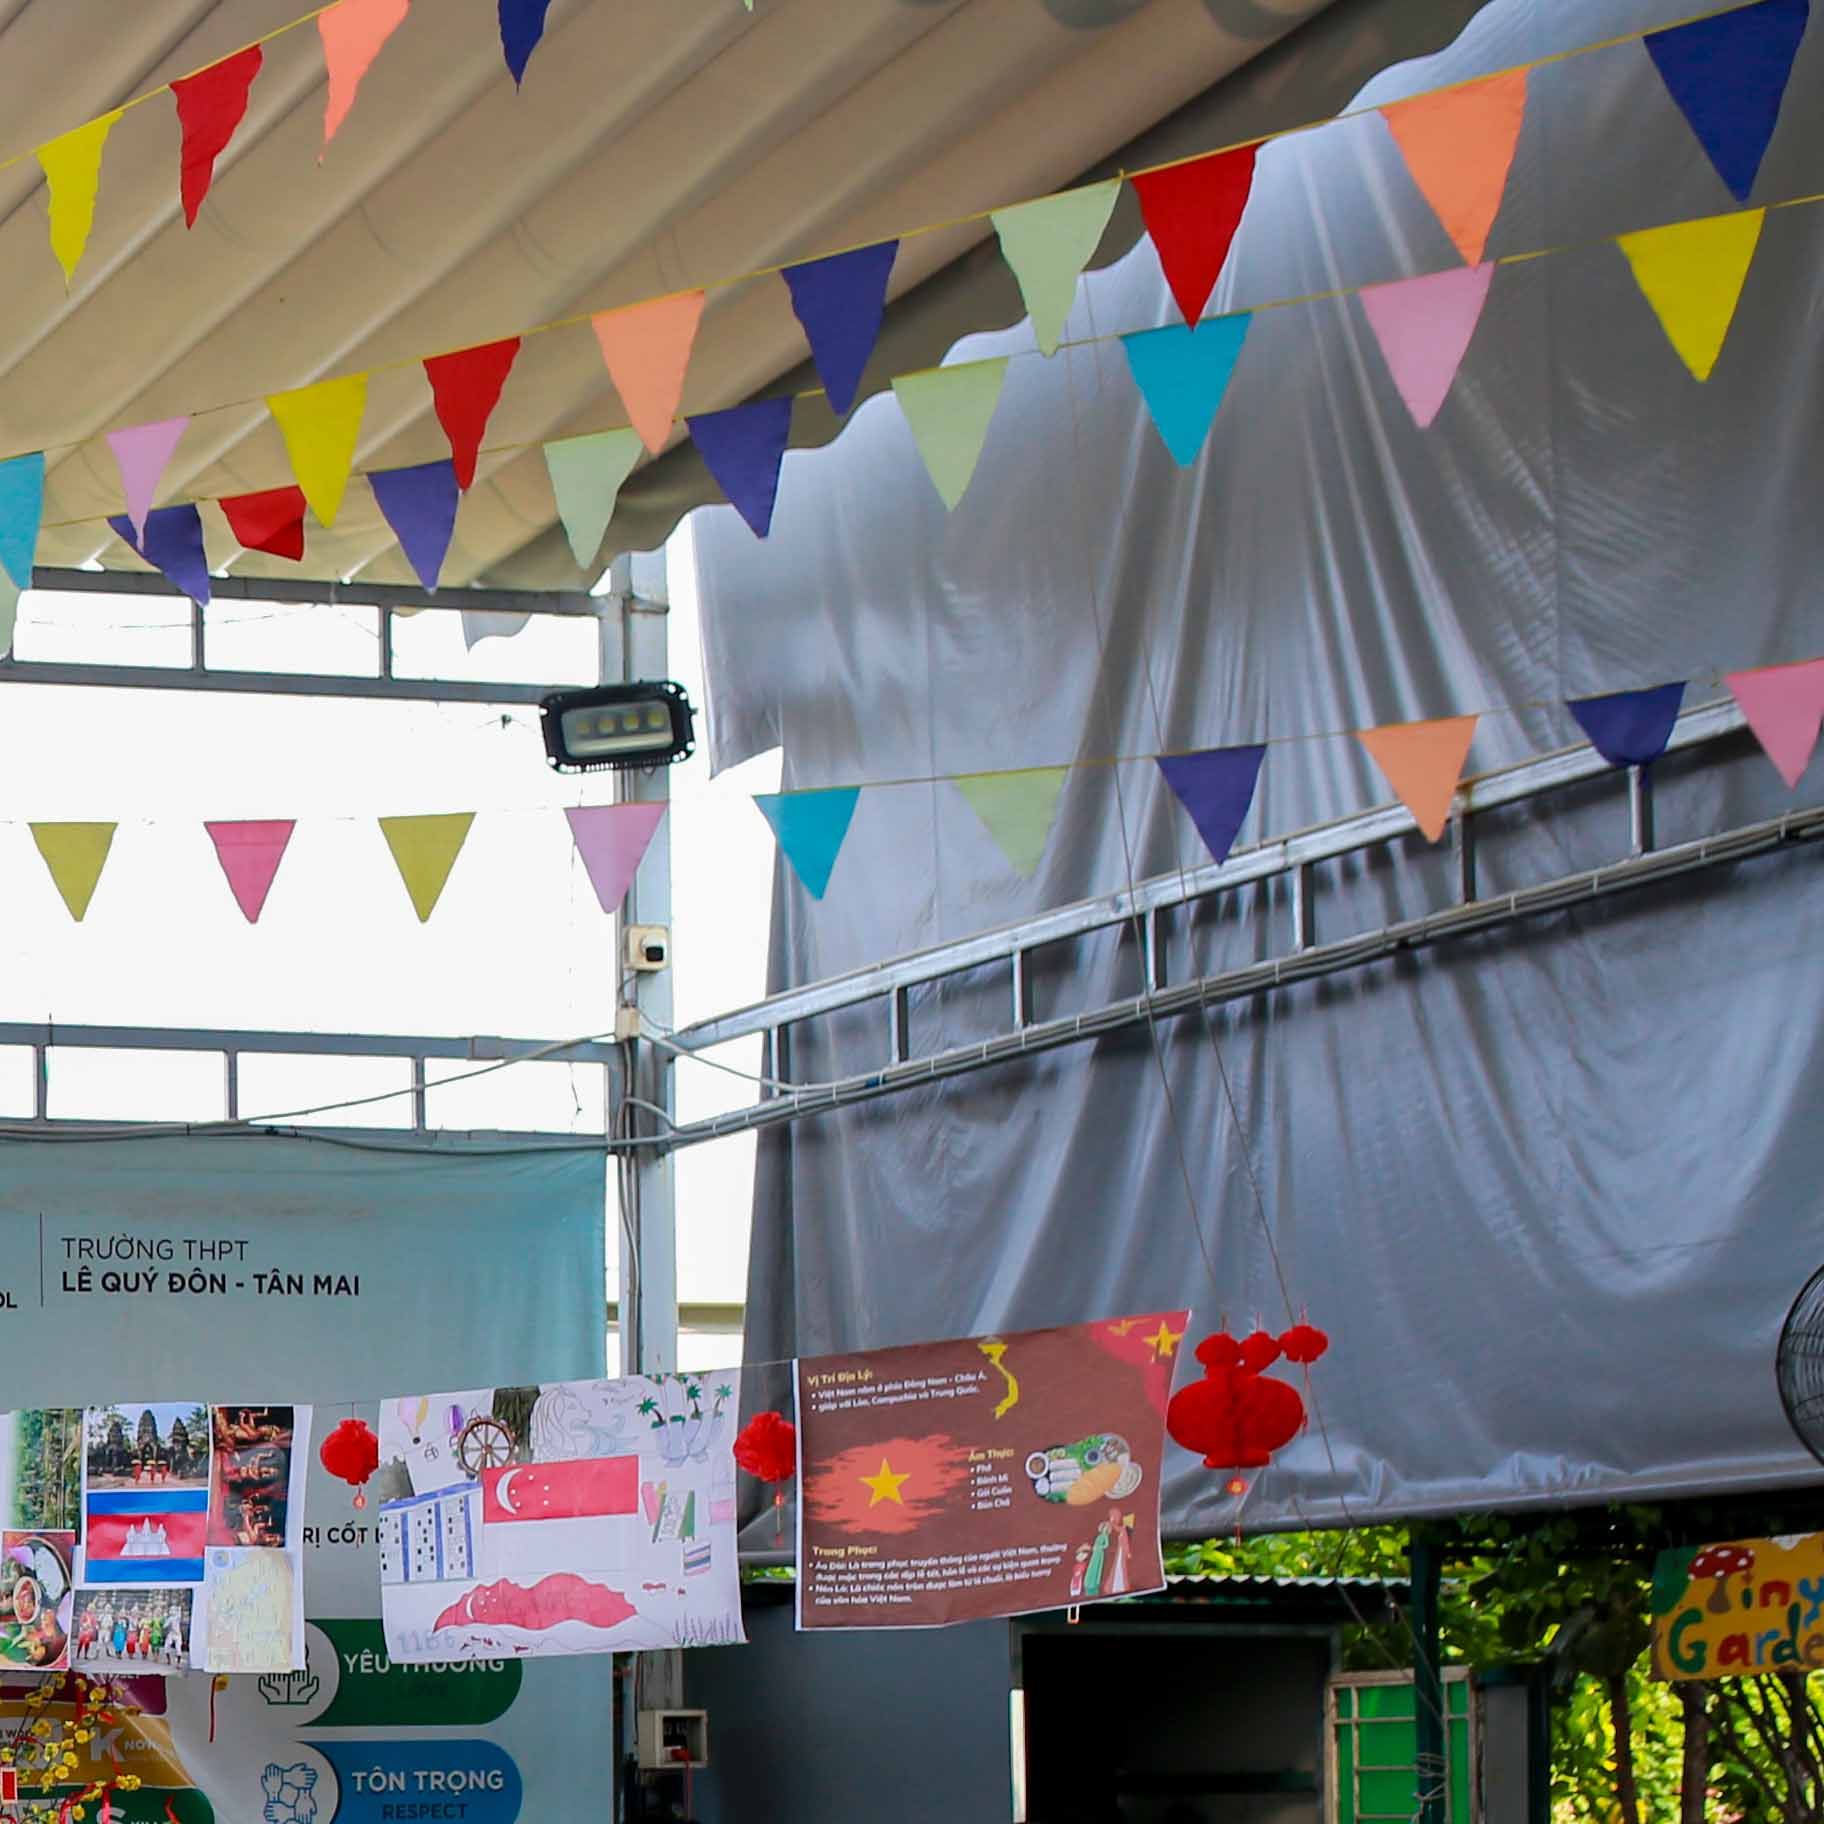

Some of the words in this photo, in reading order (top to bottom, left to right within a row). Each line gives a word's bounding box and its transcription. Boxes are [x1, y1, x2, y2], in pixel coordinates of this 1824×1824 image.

[60, 1232, 174, 1261] TRƯỜNG
[182, 1239, 249, 1261] THPT
[61, 1267, 94, 1293] LÊ
[100, 1267, 159, 1297] QUÝ
[167, 1269, 229, 1295] ĐÔN
[253, 1269, 306, 1297] TÂN
[314, 1275, 361, 1297] MAI
[327, 1519, 369, 1544] CỐT
[812, 1545, 845, 1559] Trang
[343, 1648, 391, 1674] YÊU
[352, 1766, 405, 1792] TÔN
[413, 1769, 504, 1796] TRỌNG
[382, 1803, 469, 1820] RESPECT
